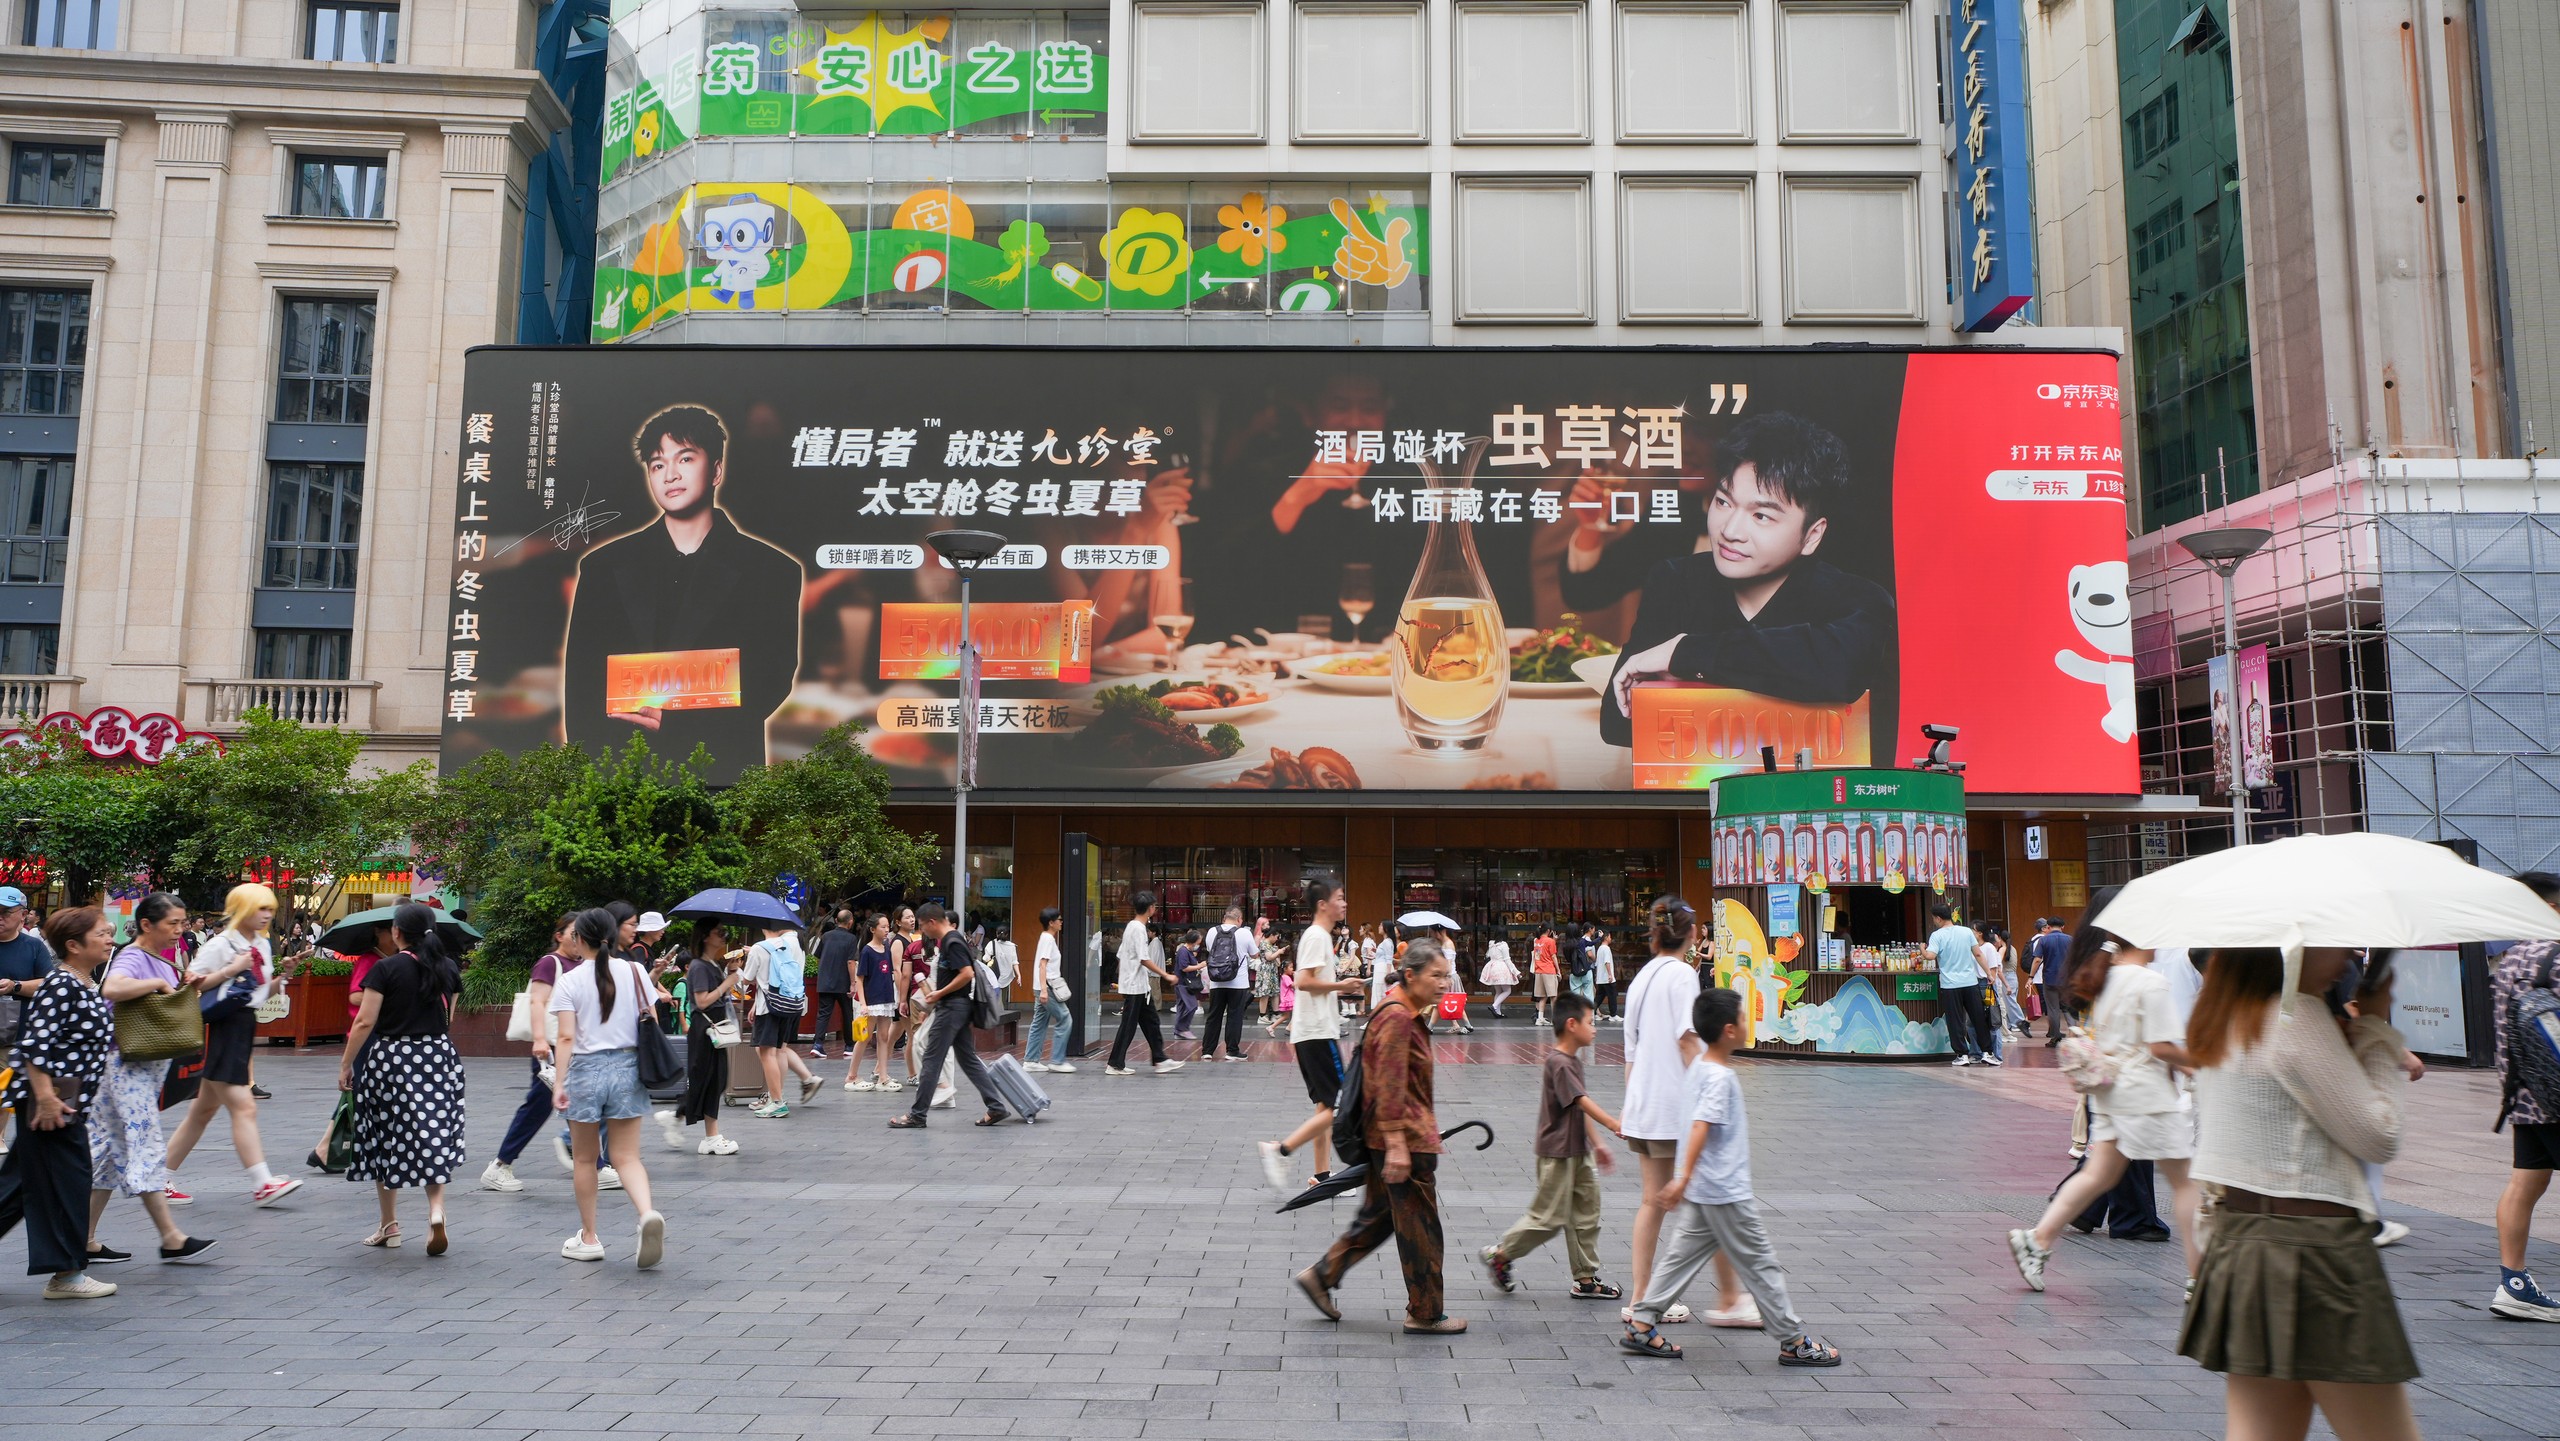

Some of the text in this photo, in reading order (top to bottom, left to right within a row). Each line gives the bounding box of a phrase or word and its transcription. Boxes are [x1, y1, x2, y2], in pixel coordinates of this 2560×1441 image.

[769, 26, 816, 56] GO!
[816, 41, 1093, 95] 安心之选
[526, 382, 543, 490] 懂局者冬虫夏草推荐官
[544, 381, 561, 510] 九珍堂品牌董事长 章绍宁
[791, 427, 917, 467] 懂局者
[1314, 404, 1683, 469] 酒局碰杯 虫草酒
[858, 478, 1147, 517] 太空舱冬虫夏草
[1371, 488, 1682, 523] 体面藏在每一口里
[2033, 481, 2068, 495] 京东
[448, 413, 494, 722] 餐桌上的冬虫夏草
[828, 548, 913, 566] 锁鲜嚼着吃
[1073, 548, 1158, 565] 携带又方便
[2241, 655, 2264, 669] GUCCI
[1658, 709, 1845, 760] 5000
[1854, 784, 1898, 796] 东方树叶
[1903, 982, 1932, 993] 东方树叶
[2402, 1004, 2425, 1012] HUAWEI
